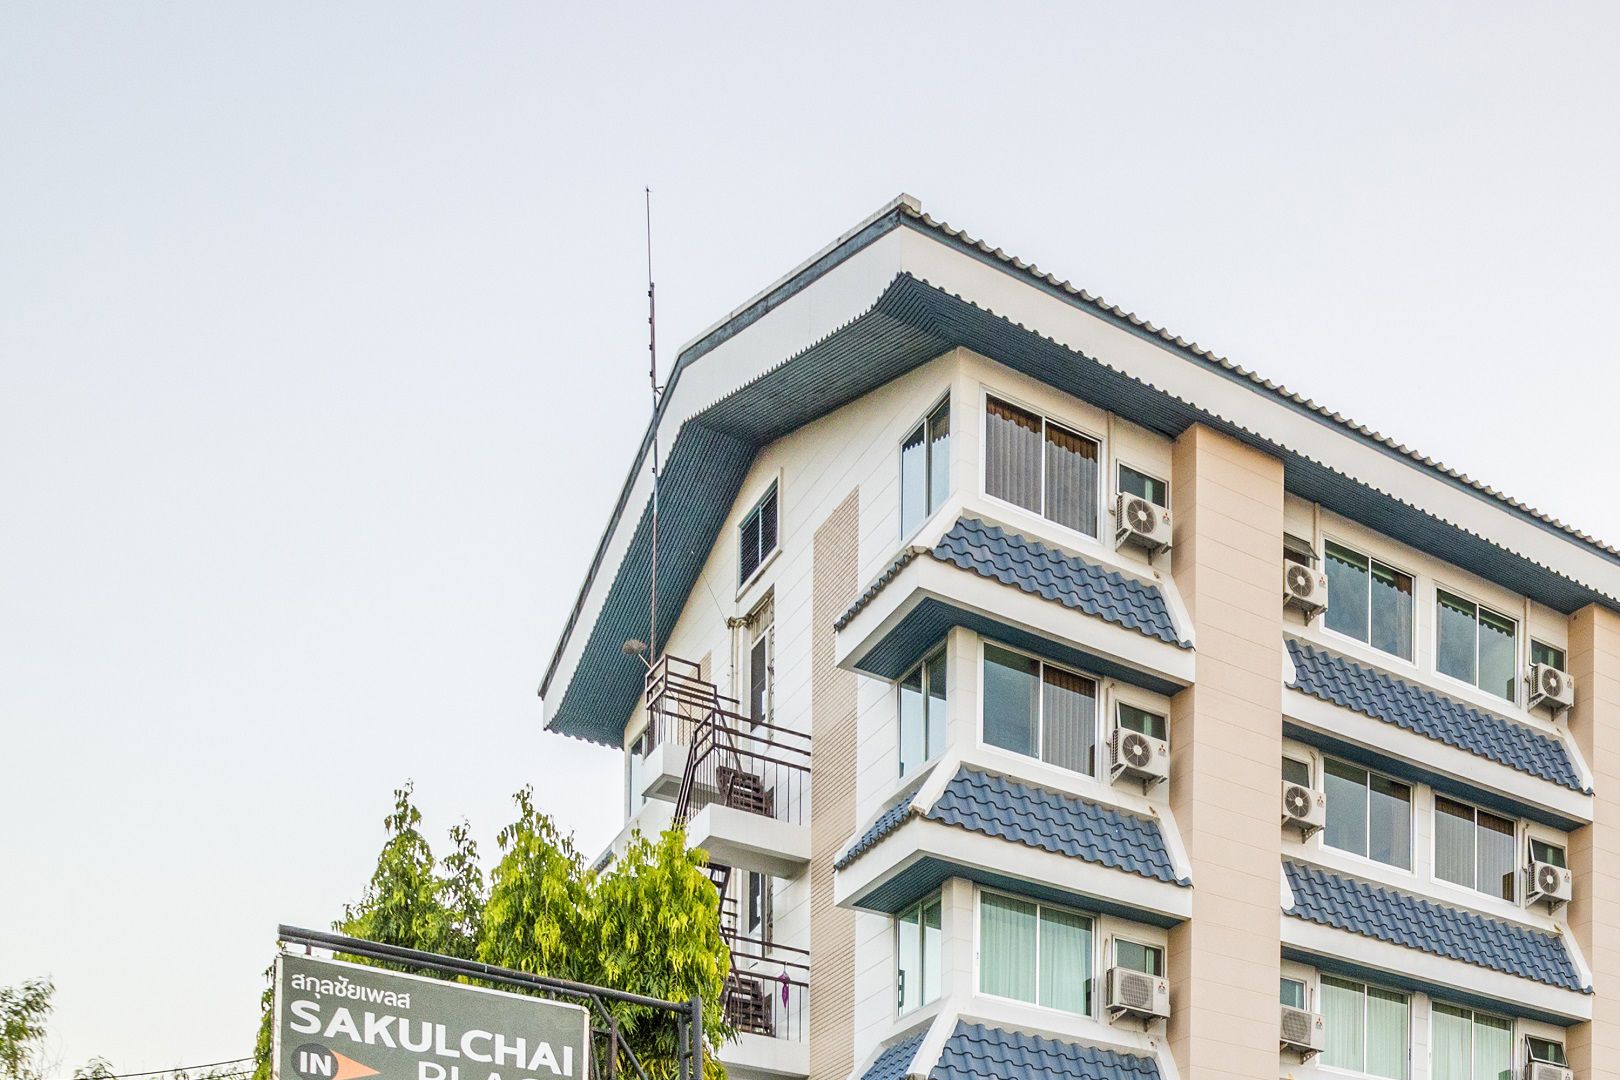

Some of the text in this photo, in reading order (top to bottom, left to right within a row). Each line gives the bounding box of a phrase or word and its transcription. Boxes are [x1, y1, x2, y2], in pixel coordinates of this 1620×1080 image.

[291, 974, 411, 1009] สกุลชัยเพลส
[290, 1000, 573, 1077] SAKULCHAI
[300, 1051, 332, 1077] IN
